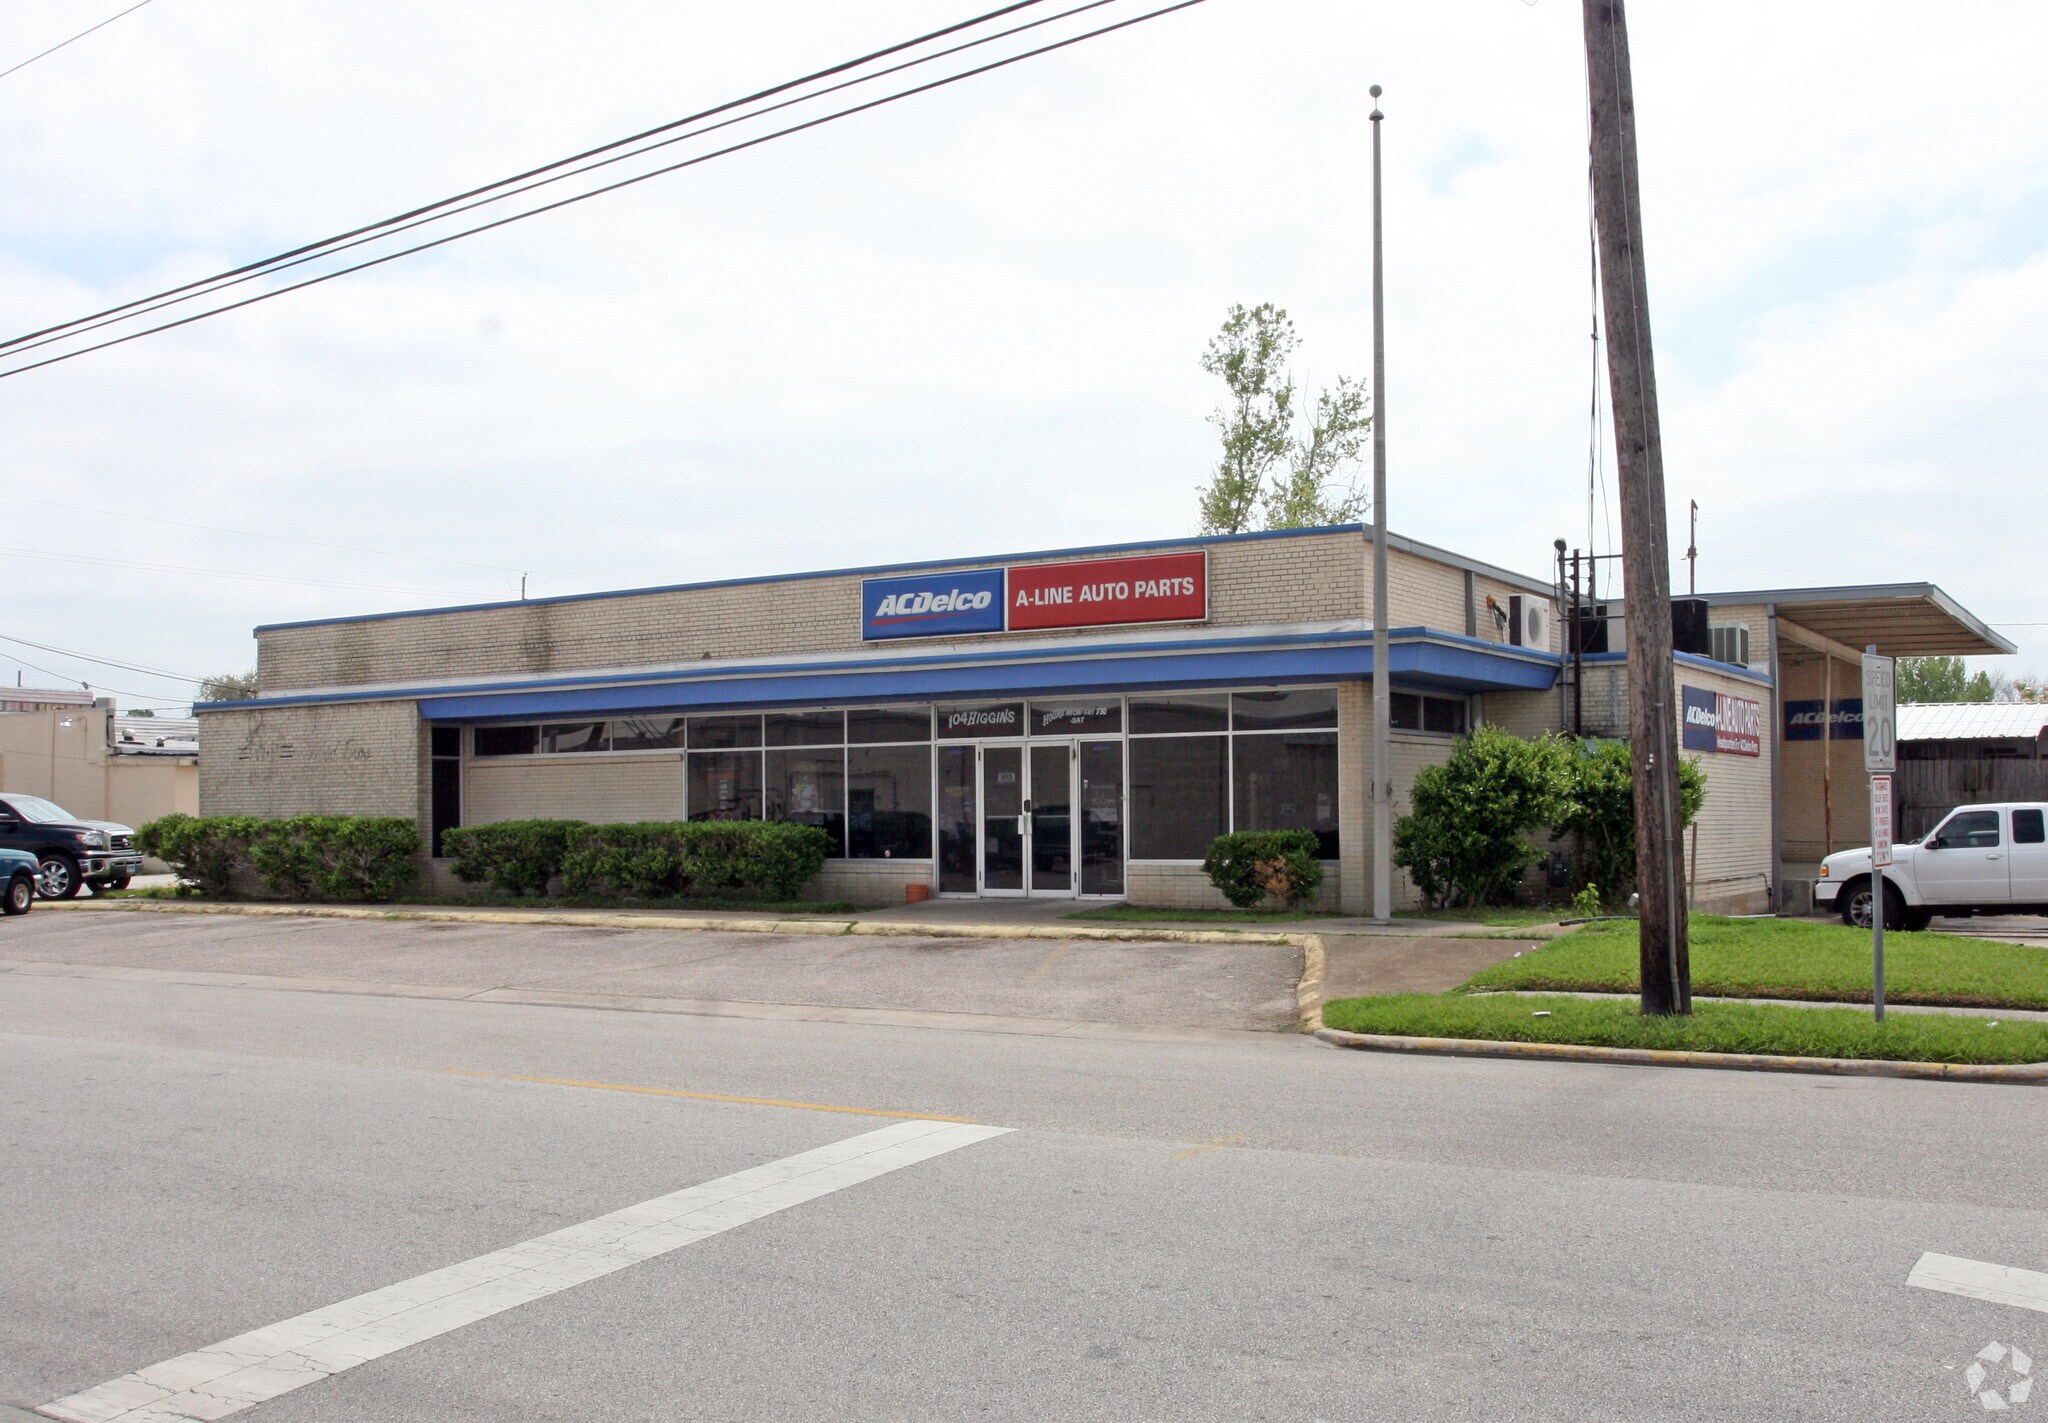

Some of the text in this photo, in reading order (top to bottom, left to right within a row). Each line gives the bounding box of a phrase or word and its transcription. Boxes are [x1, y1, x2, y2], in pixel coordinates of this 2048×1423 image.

[875, 589, 992, 616] ACDelco
[1015, 577, 1195, 607] A-LINE AUTO PARTS
[1866, 670, 1891, 688] SPEED
[1869, 693, 1889, 711] LIMIT
[1070, 716, 1085, 724] SAT
[1686, 705, 1715, 727] ACDelco
[1732, 698, 1745, 735] AUTO
[1745, 700, 1760, 737] PARTS
[1867, 716, 1892, 757] 20
